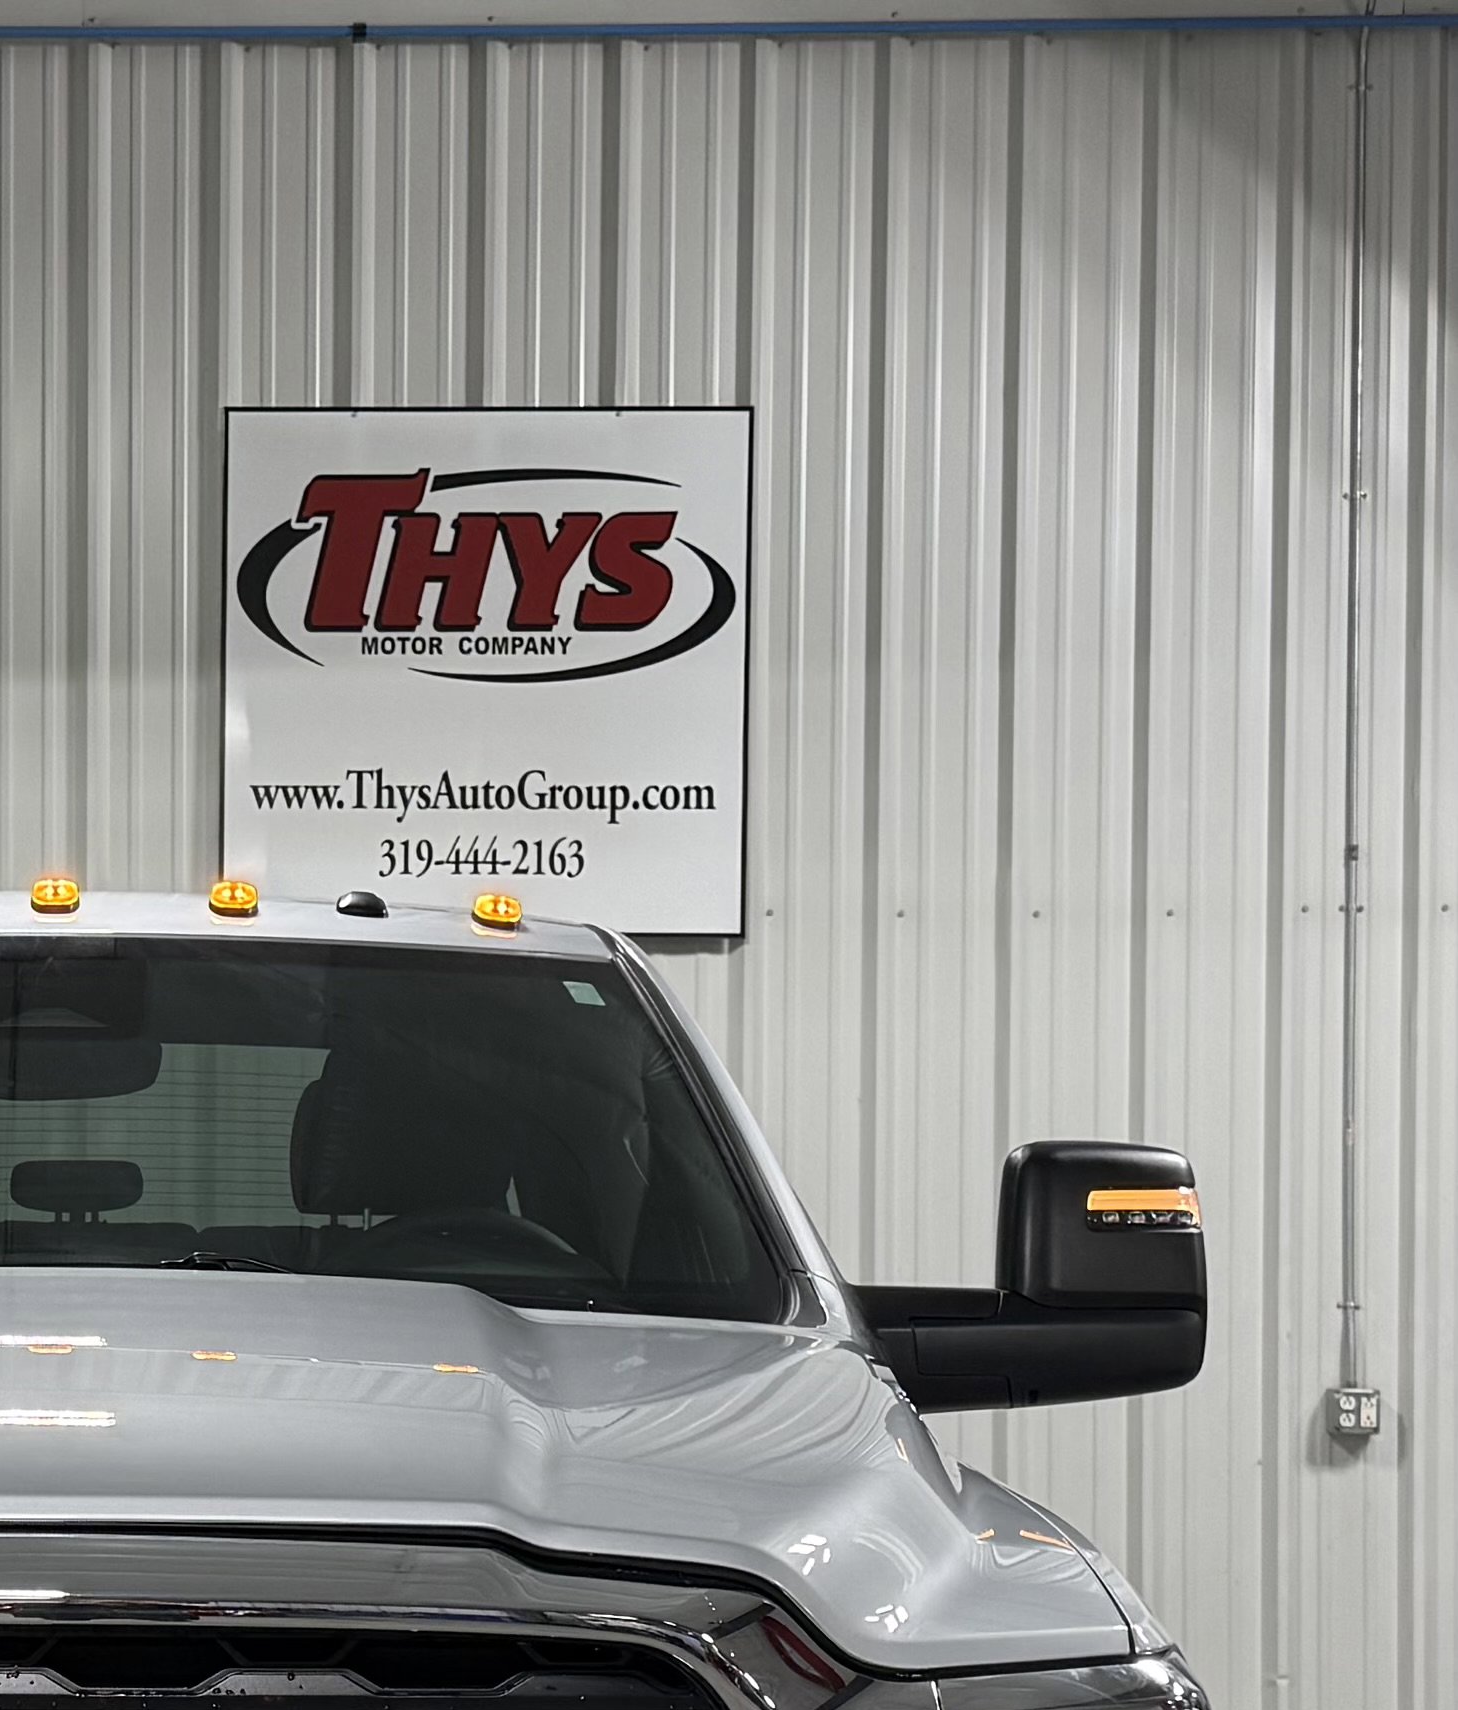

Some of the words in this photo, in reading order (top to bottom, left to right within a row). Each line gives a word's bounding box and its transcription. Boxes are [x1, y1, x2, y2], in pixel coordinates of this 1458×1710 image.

[297, 467, 678, 632] THYS
[361, 637, 443, 656] MOTOR
[458, 637, 572, 656] COMPANY
[249, 768, 716, 824] www.ThysAutoGroup.com
[379, 836, 585, 878] 319-444-2163
